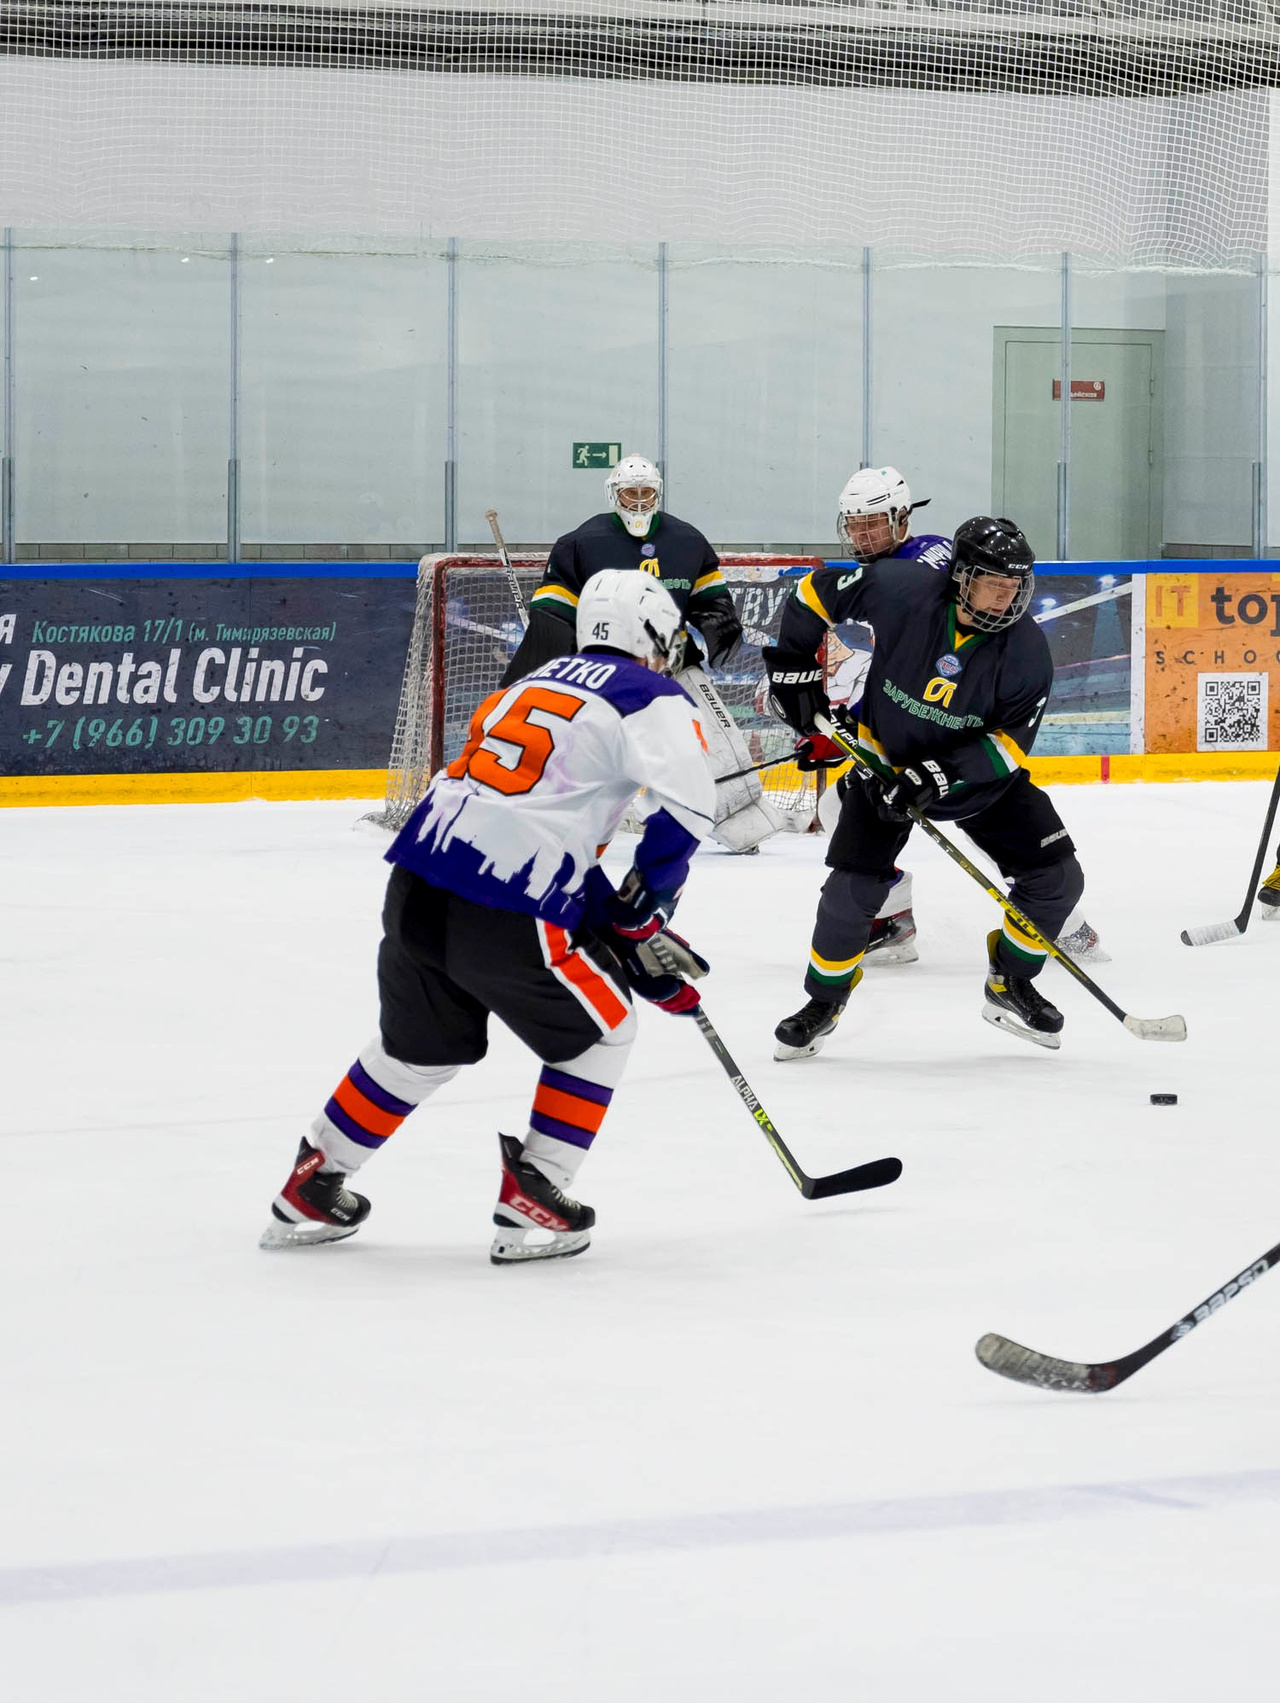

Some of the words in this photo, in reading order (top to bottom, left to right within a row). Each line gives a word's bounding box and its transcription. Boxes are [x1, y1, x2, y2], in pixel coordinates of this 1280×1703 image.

[837, 567, 863, 591] 3
[1155, 586, 1191, 617] IT
[32, 619, 136, 644] Костякова
[143, 618, 183, 646] 17/1
[189, 623, 209, 644] (м.
[215, 620, 337, 646] Тимирязевская)
[592, 622, 610, 641] 45
[20, 648, 182, 706] Dental
[192, 646, 329, 704] Clinic
[771, 668, 823, 685] BAUE
[699, 684, 731, 728] BAUER
[22, 718, 66, 749] +7
[73, 715, 158, 751] (966)
[167, 716, 226, 747] 309
[232, 715, 272, 745] 30
[283, 714, 320, 744] 93
[731, 1075, 758, 1111] ALPHA
[296, 1156, 320, 1176] CCM
[509, 1195, 571, 1232] CCM
